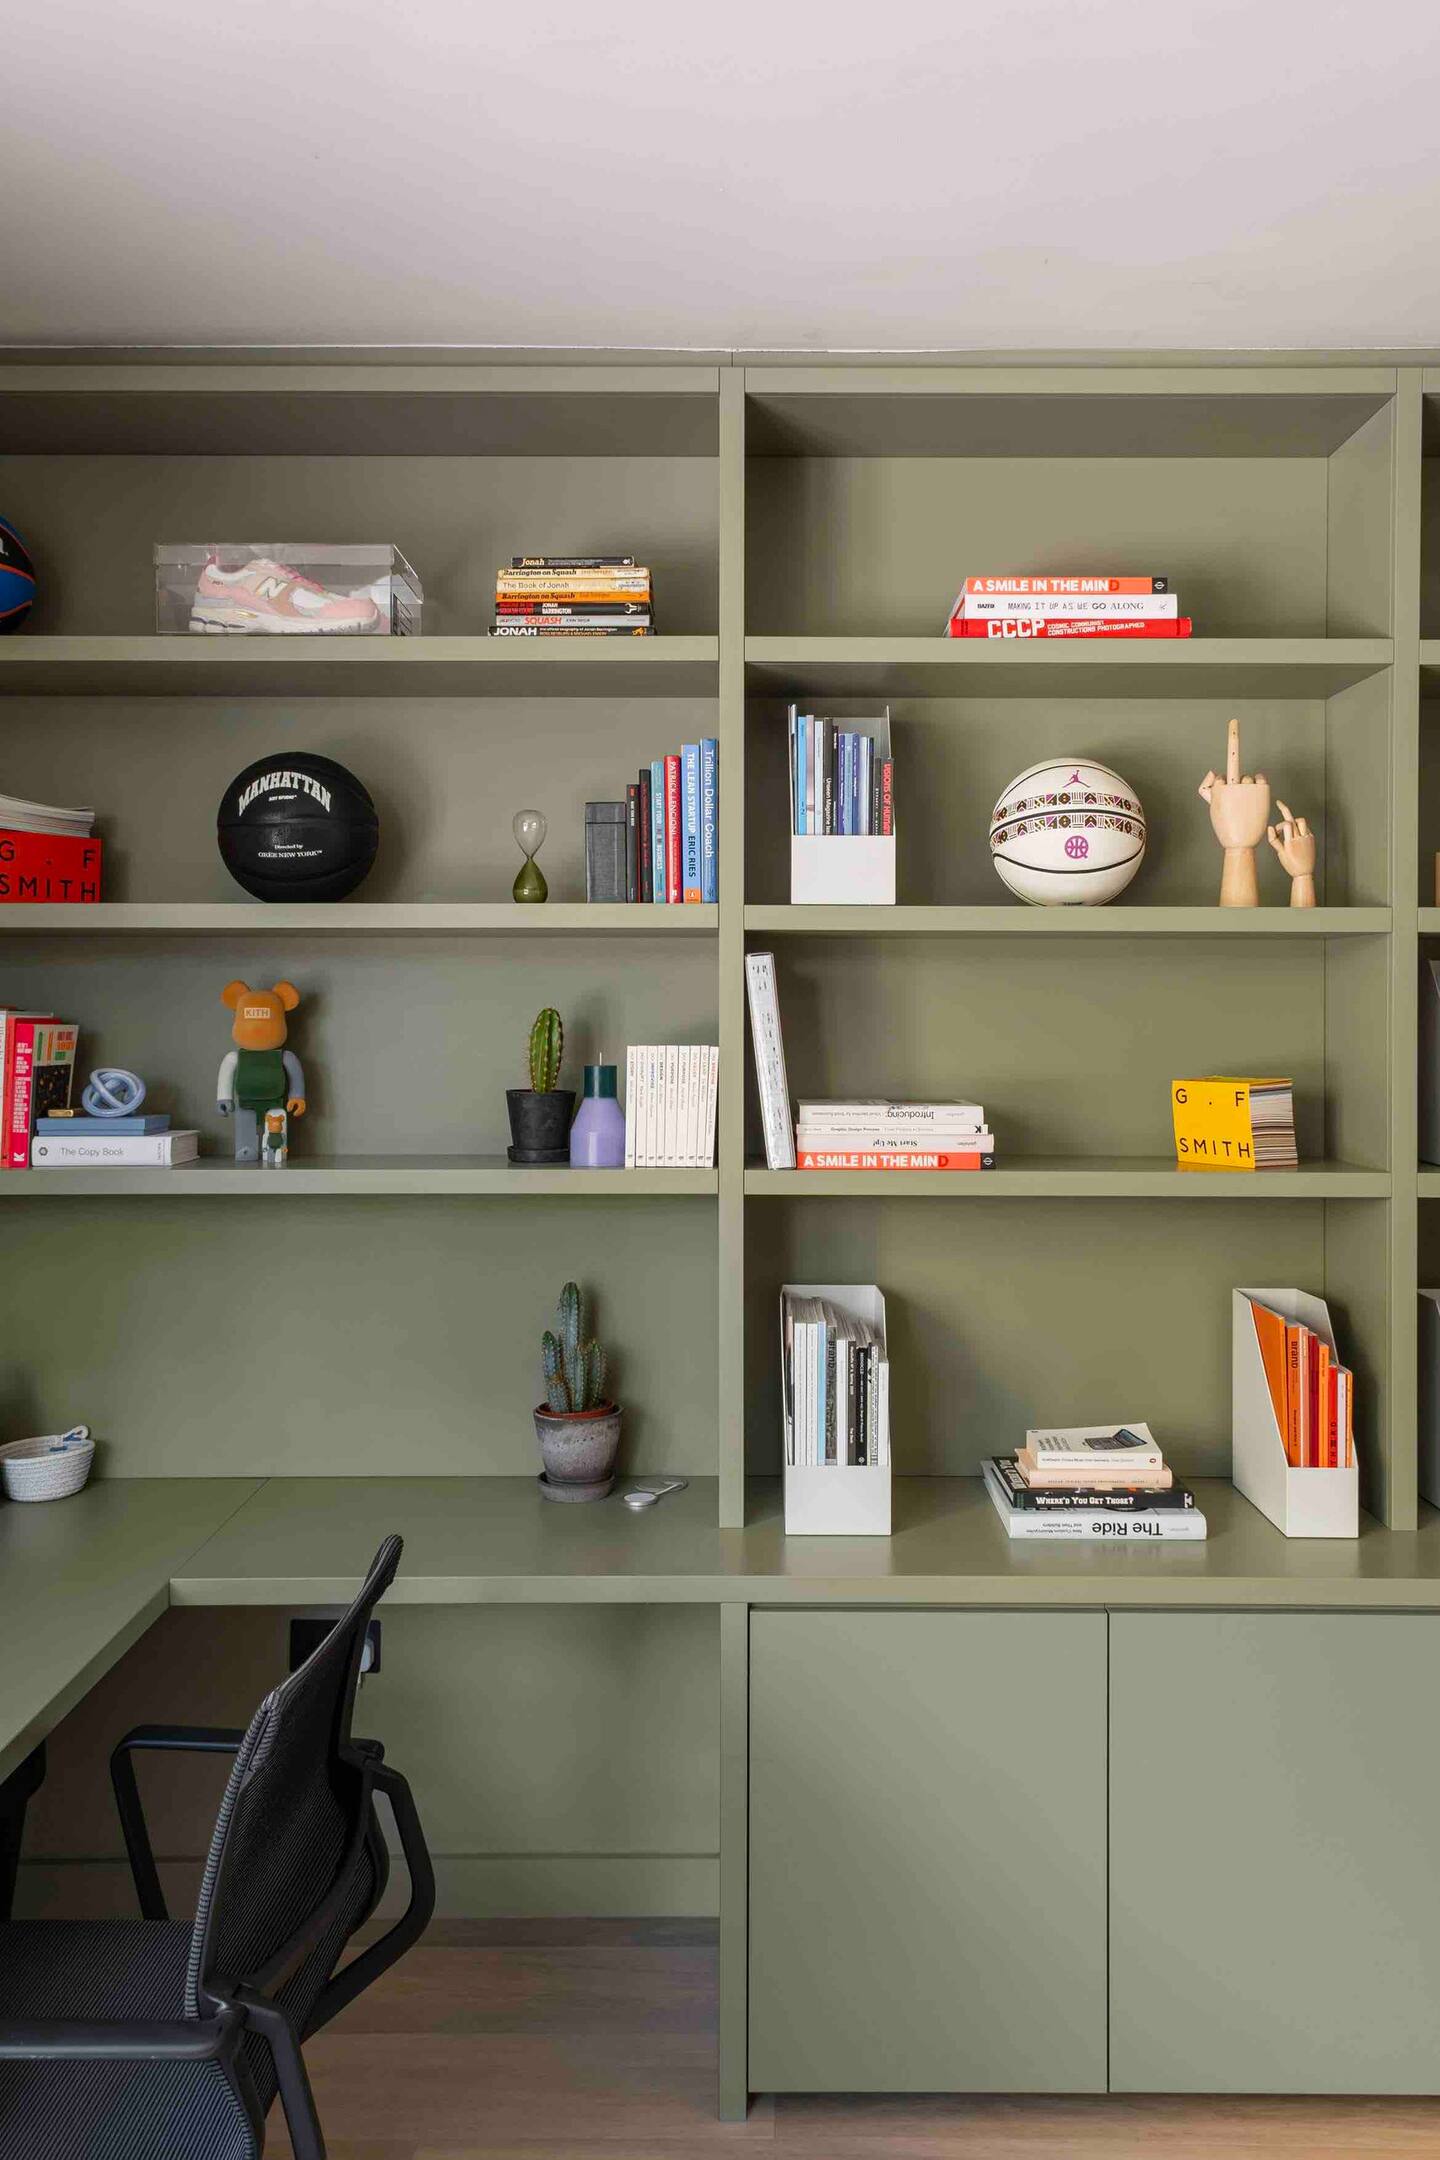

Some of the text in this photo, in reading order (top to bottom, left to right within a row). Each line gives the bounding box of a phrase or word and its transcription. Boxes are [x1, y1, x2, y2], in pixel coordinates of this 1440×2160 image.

[521, 558, 545, 567] Jonah
[503, 569, 541, 577] Barrington
[552, 568, 577, 577] Squash
[973, 579, 1120, 592] A SMILE IN THE MIND
[502, 592, 541, 600] Barrington
[551, 592, 576, 600] Squash
[1007, 602, 1144, 610] MAKING IT UP AS WE GO ALONG
[524, 616, 562, 626] SQUASH
[987, 618, 1045, 638] CCCP
[1097, 621, 1145, 632] PHOTOGRAPHED
[493, 627, 538, 636] JONAH
[704, 749, 714, 786] Trillion
[667, 761, 677, 794] PATRICK
[238, 771, 332, 817] MANHATTAN
[824, 777, 832, 799] Unseen
[704, 788, 714, 820] Dollar
[668, 796, 677, 835] LENCIONI
[687, 752, 697, 878] THE LEAN STARTUP ERIC RIES
[823, 799, 832, 825] Magazine
[704, 823, 714, 858] Coach
[0, 840, 15, 862] G
[83, 849, 96, 869] F
[0, 873, 97, 902] SMITH
[245, 1008, 269, 1017] KITH
[1175, 1088, 1188, 1104] G
[1235, 1091, 1245, 1107] F
[974, 1125, 982, 1133] K
[872, 1139, 885, 1147] Up!
[1179, 1137, 1251, 1158] SMITH
[61, 1147, 124, 1160] The Copy Book
[803, 1154, 949, 1167] A SMILE IN THE MIND
[1035, 1496, 1134, 1505] WHERE'D YOU GET THOSE?
[1092, 1522, 1163, 1536] The Ride
